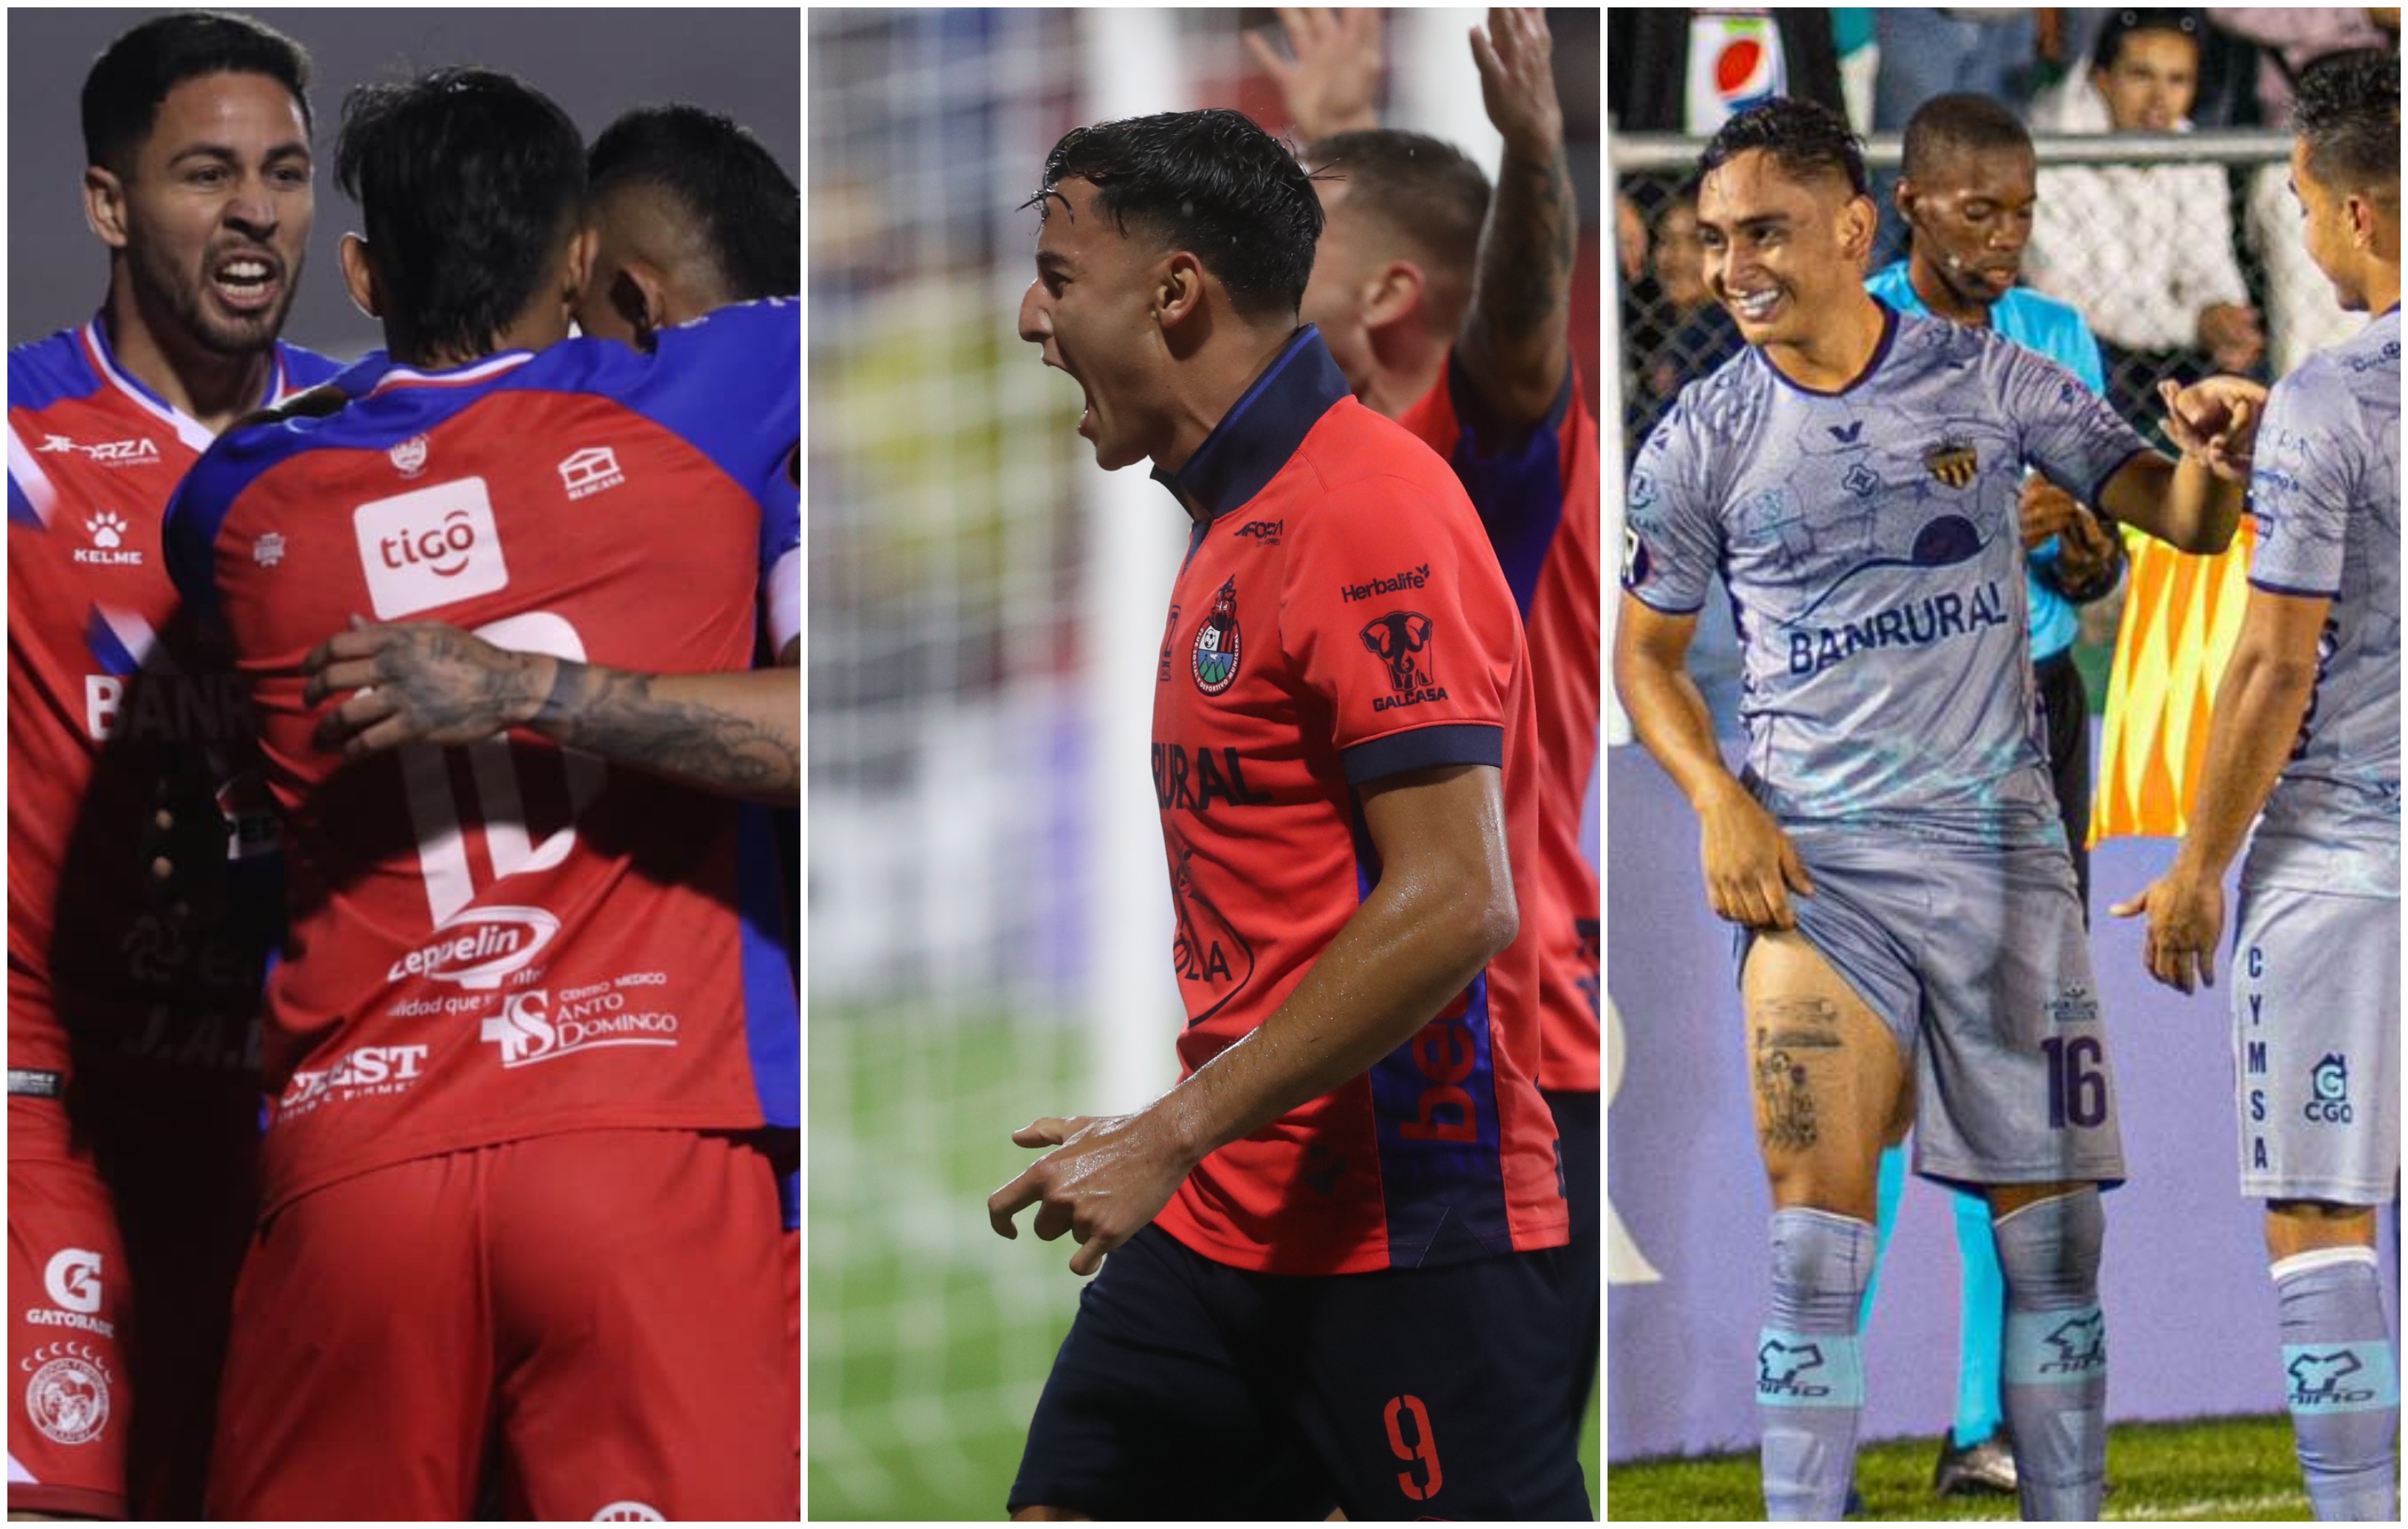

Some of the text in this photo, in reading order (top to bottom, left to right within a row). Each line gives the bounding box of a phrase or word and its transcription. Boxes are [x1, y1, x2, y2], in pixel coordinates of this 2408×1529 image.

[74, 548, 143, 565] KELME
[1341, 571, 1425, 603] Herbalife
[1790, 581, 2008, 674] BANRURAL
[1200, 679, 1228, 692] DEPORTIVO
[1228, 633, 1239, 679] MUNICIPAL
[1373, 687, 1448, 712] GALCASA
[558, 1013, 677, 1049] DOMINGO
[2248, 947, 2268, 1169] CYMSA
[2040, 1036, 2107, 1130] 16
[2305, 1102, 2353, 1123] CGO
[44, 1248, 103, 1314] G
[1383, 1394, 1443, 1501] 9
